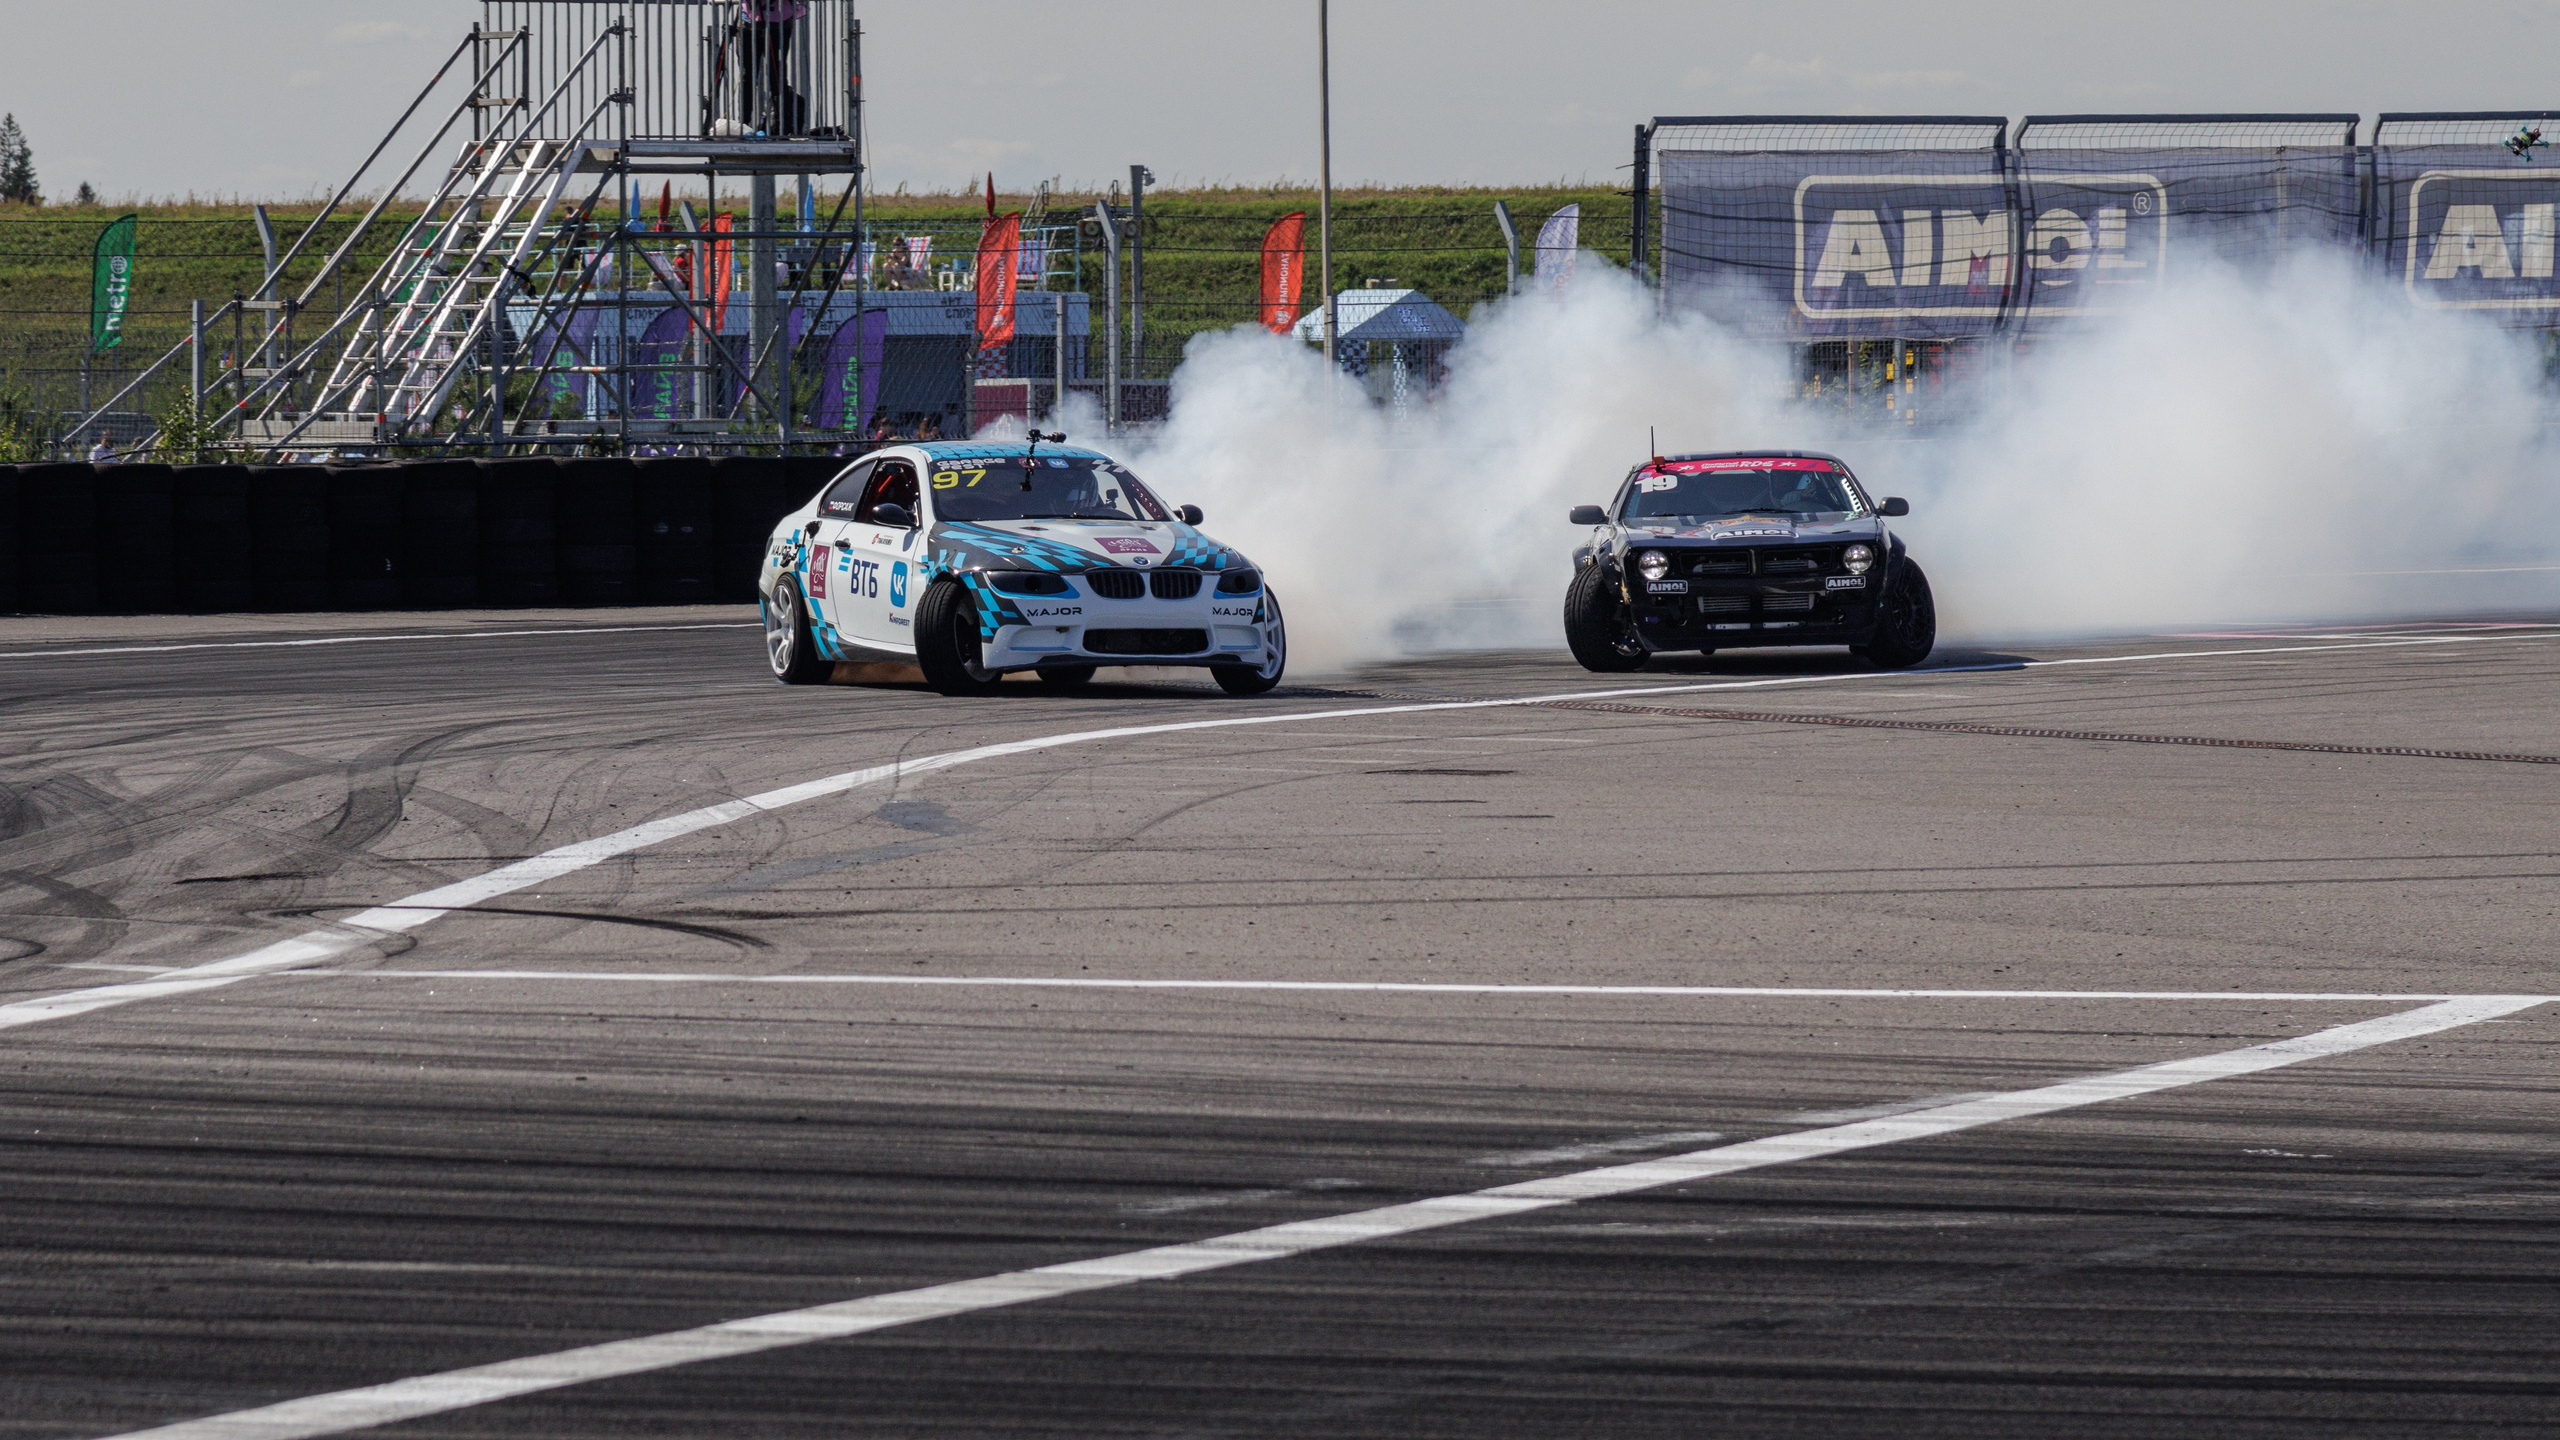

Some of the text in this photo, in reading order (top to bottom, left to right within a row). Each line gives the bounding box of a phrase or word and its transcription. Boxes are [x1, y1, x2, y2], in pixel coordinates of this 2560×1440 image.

[1811, 208, 2148, 287] AIMOL
[105, 255, 128, 331] metro
[932, 469, 987, 490] 97
[1635, 475, 1678, 494] 19
[1715, 529, 1791, 538] AIMOL
[850, 559, 879, 599] ВТБ
[1828, 578, 1864, 588] AIMOL
[1650, 582, 1686, 592] AIMOL
[1027, 606, 1083, 617] MAJOR
[1212, 606, 1254, 617] MAJOR
